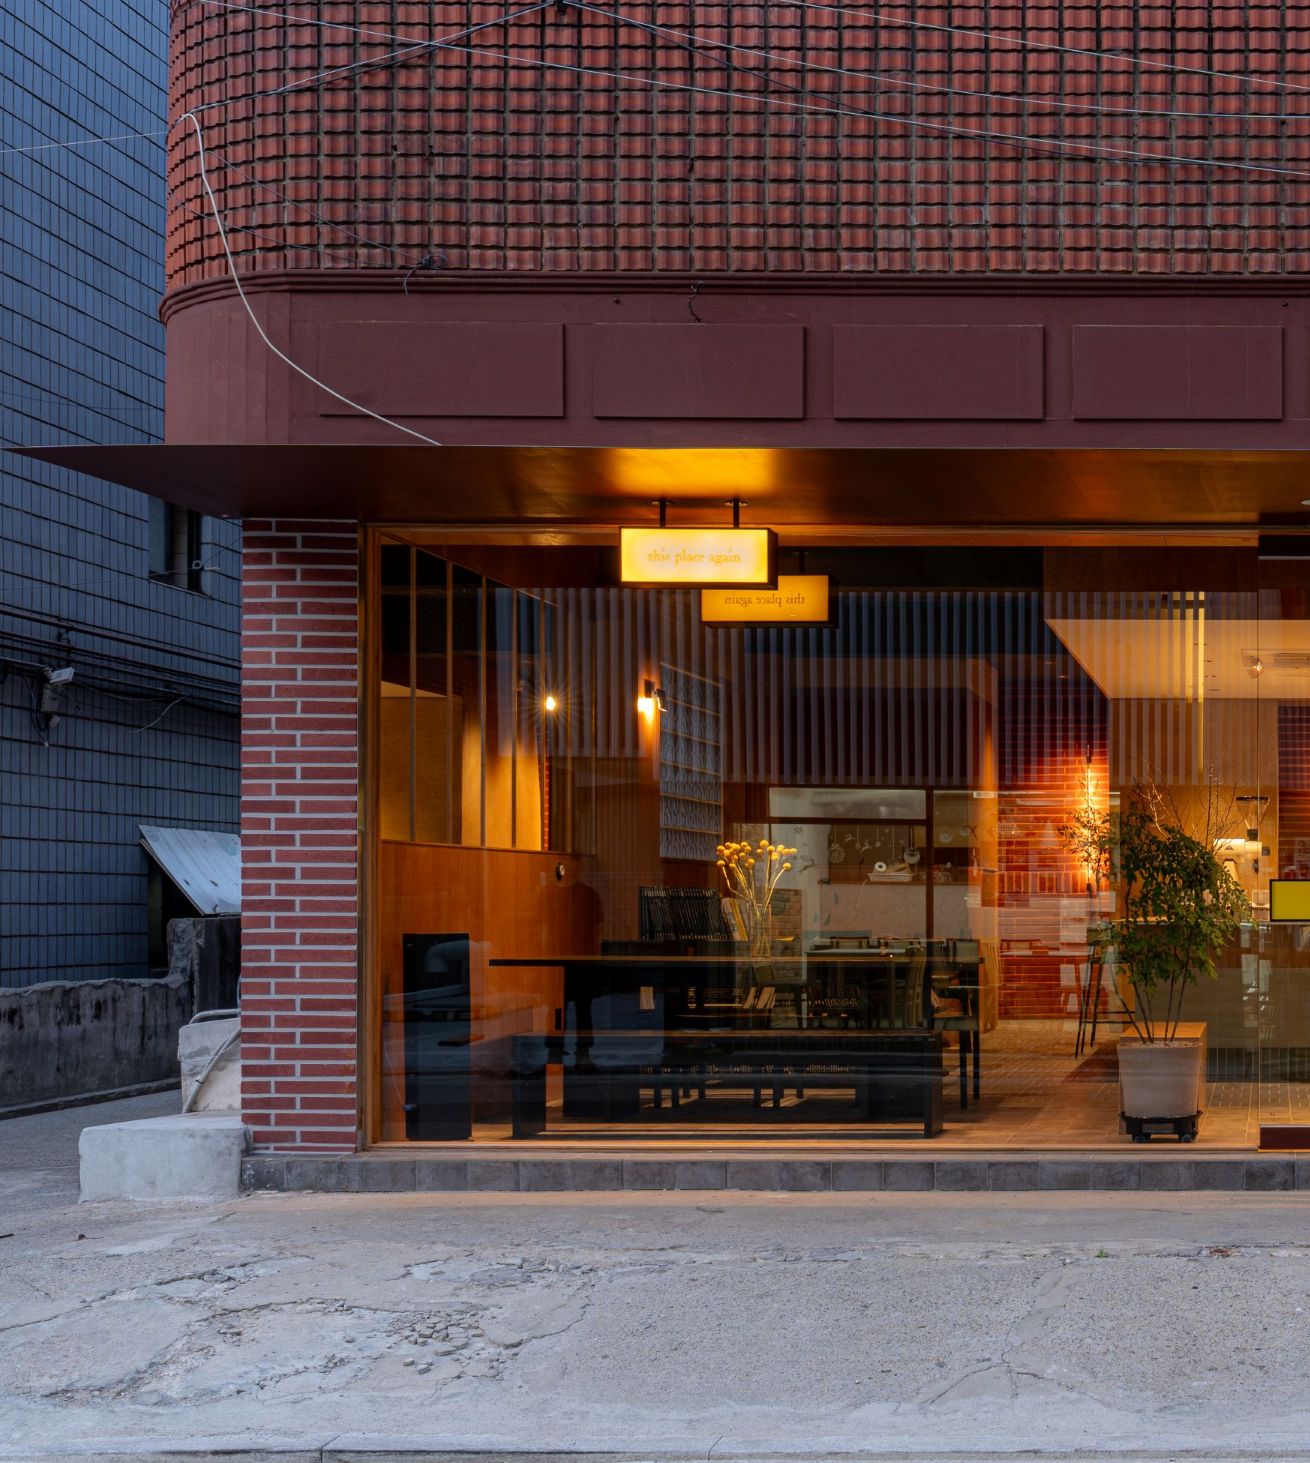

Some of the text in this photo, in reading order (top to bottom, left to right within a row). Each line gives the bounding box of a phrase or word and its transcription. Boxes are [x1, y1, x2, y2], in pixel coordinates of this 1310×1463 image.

[648, 546, 742, 567] this place again
